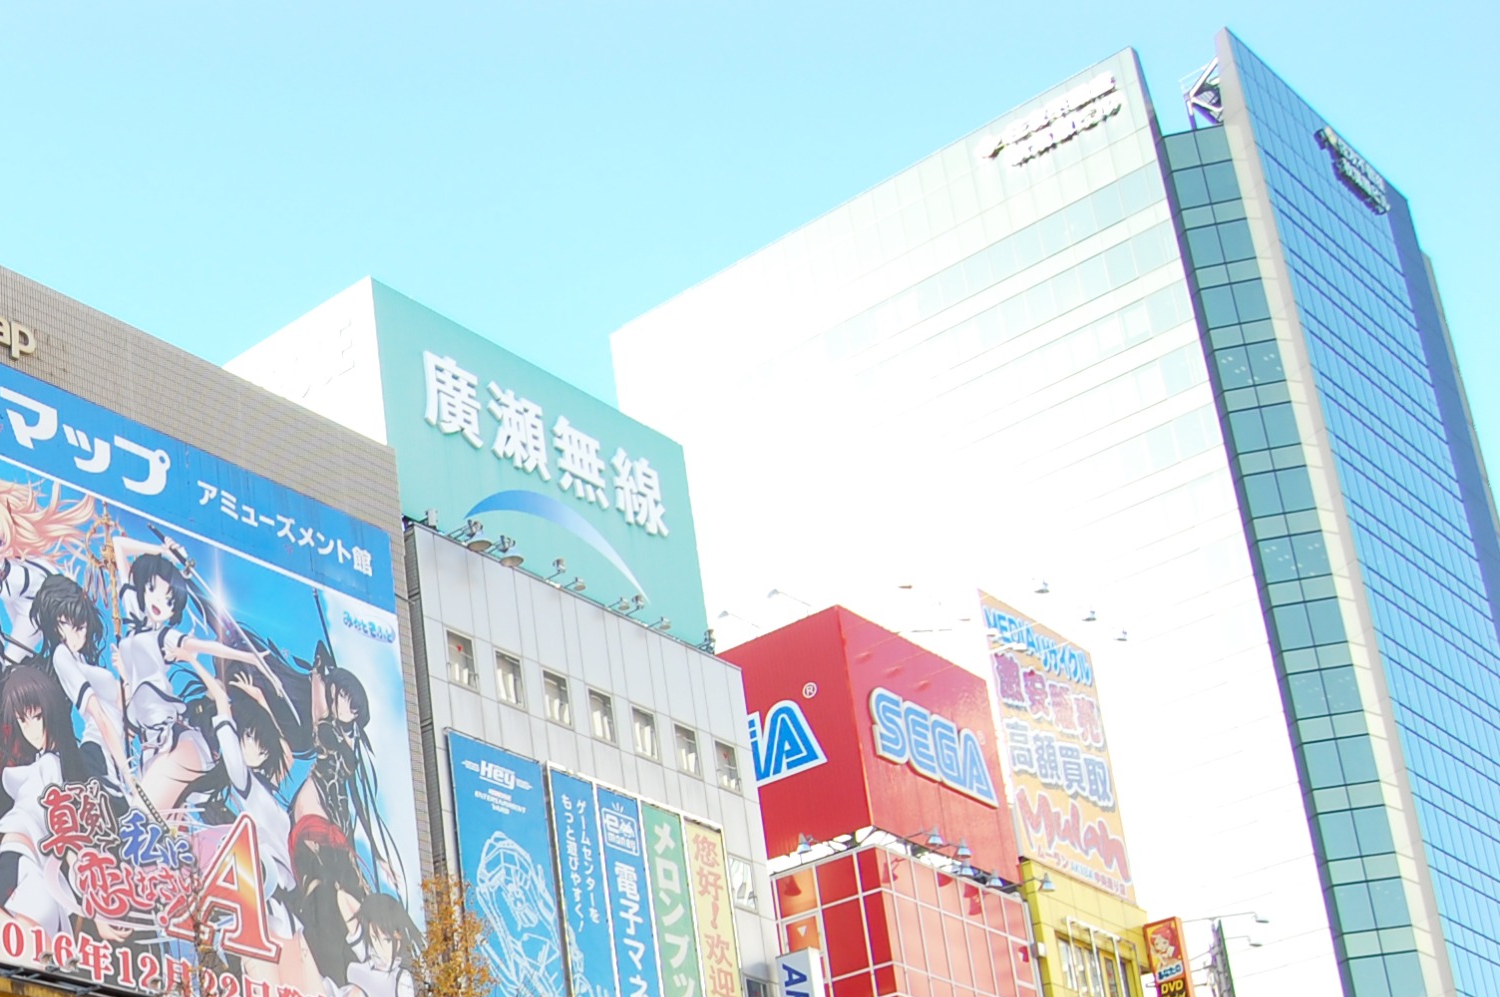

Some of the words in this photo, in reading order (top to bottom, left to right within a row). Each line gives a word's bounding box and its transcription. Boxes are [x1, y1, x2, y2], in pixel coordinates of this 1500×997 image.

[422, 349, 670, 538] 廣瀬無線
[196, 479, 374, 578] アミューズメント館
[479, 760, 516, 790] Hey
[870, 686, 999, 809] SEGA
[1003, 717, 1116, 811] 高額買取
[575, 799, 601, 925] ゲームセンターを
[1014, 785, 1132, 884] Mulan
[1161, 980, 1184, 994] DVD
